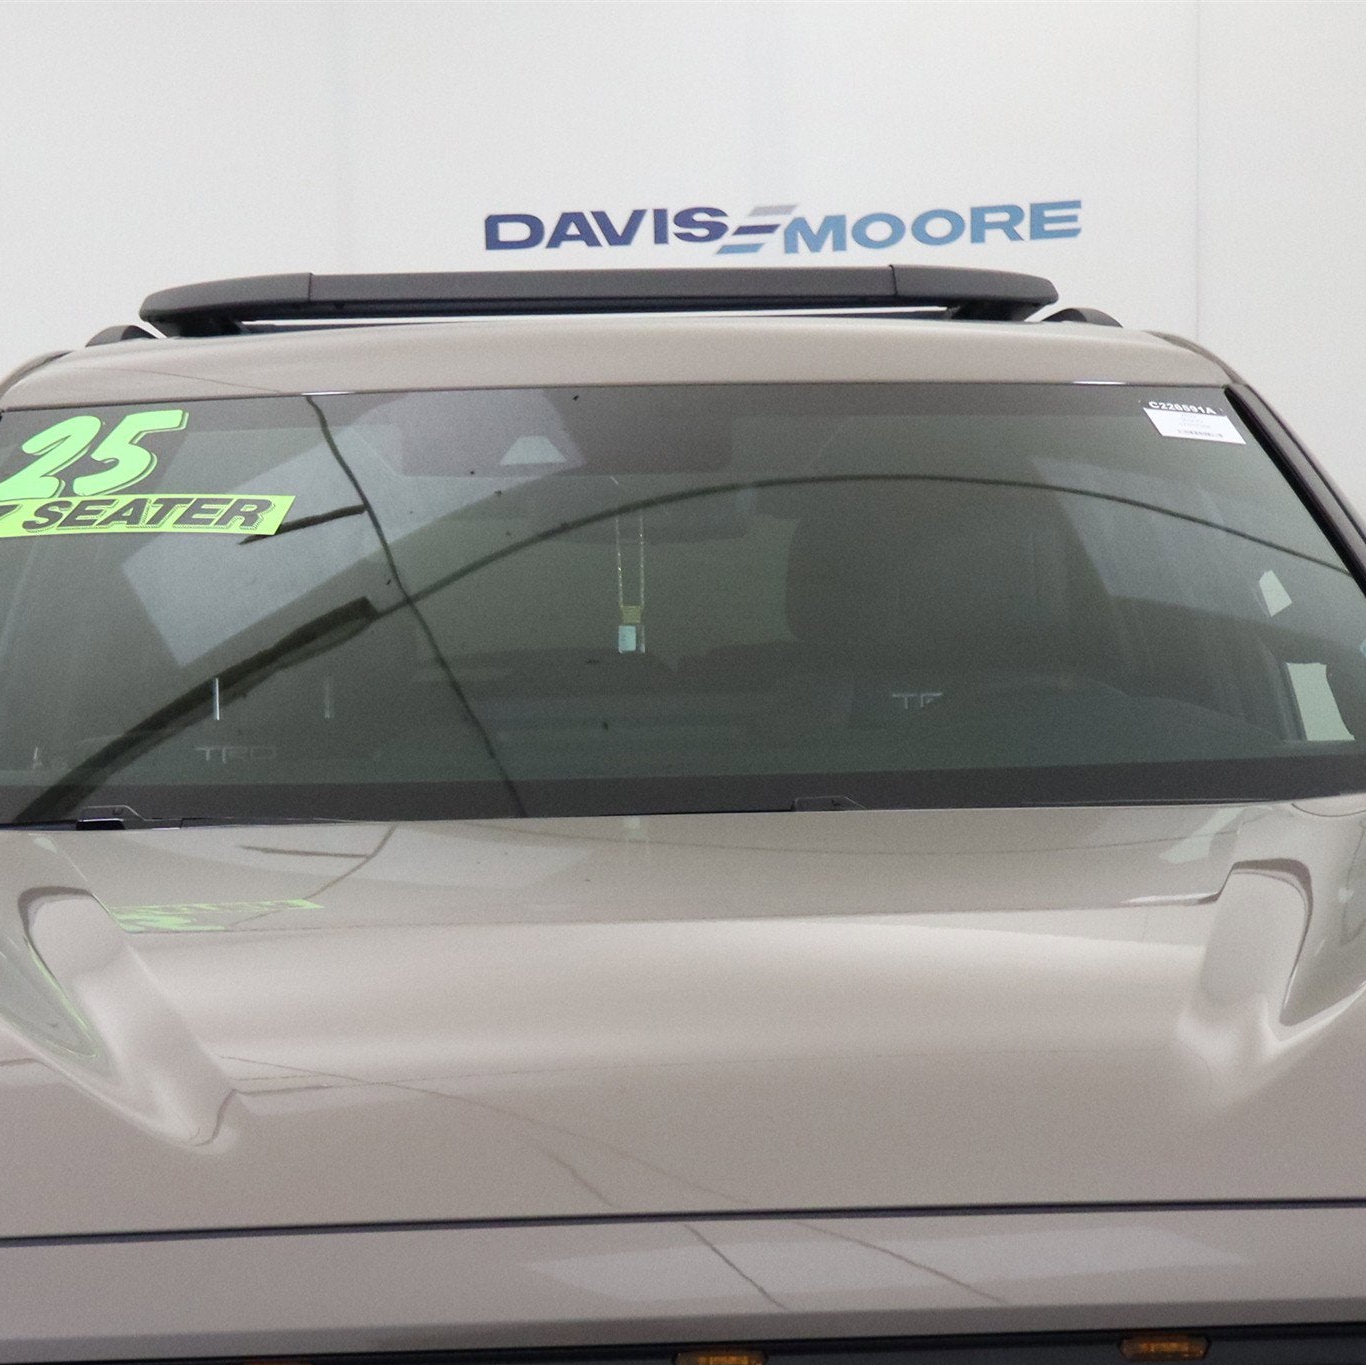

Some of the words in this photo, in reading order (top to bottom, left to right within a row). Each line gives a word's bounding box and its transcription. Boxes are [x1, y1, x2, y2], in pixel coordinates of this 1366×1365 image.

[484, 206, 729, 251] DAVIS
[784, 199, 1082, 254] MOORE
[22, 498, 276, 533] SEATER
